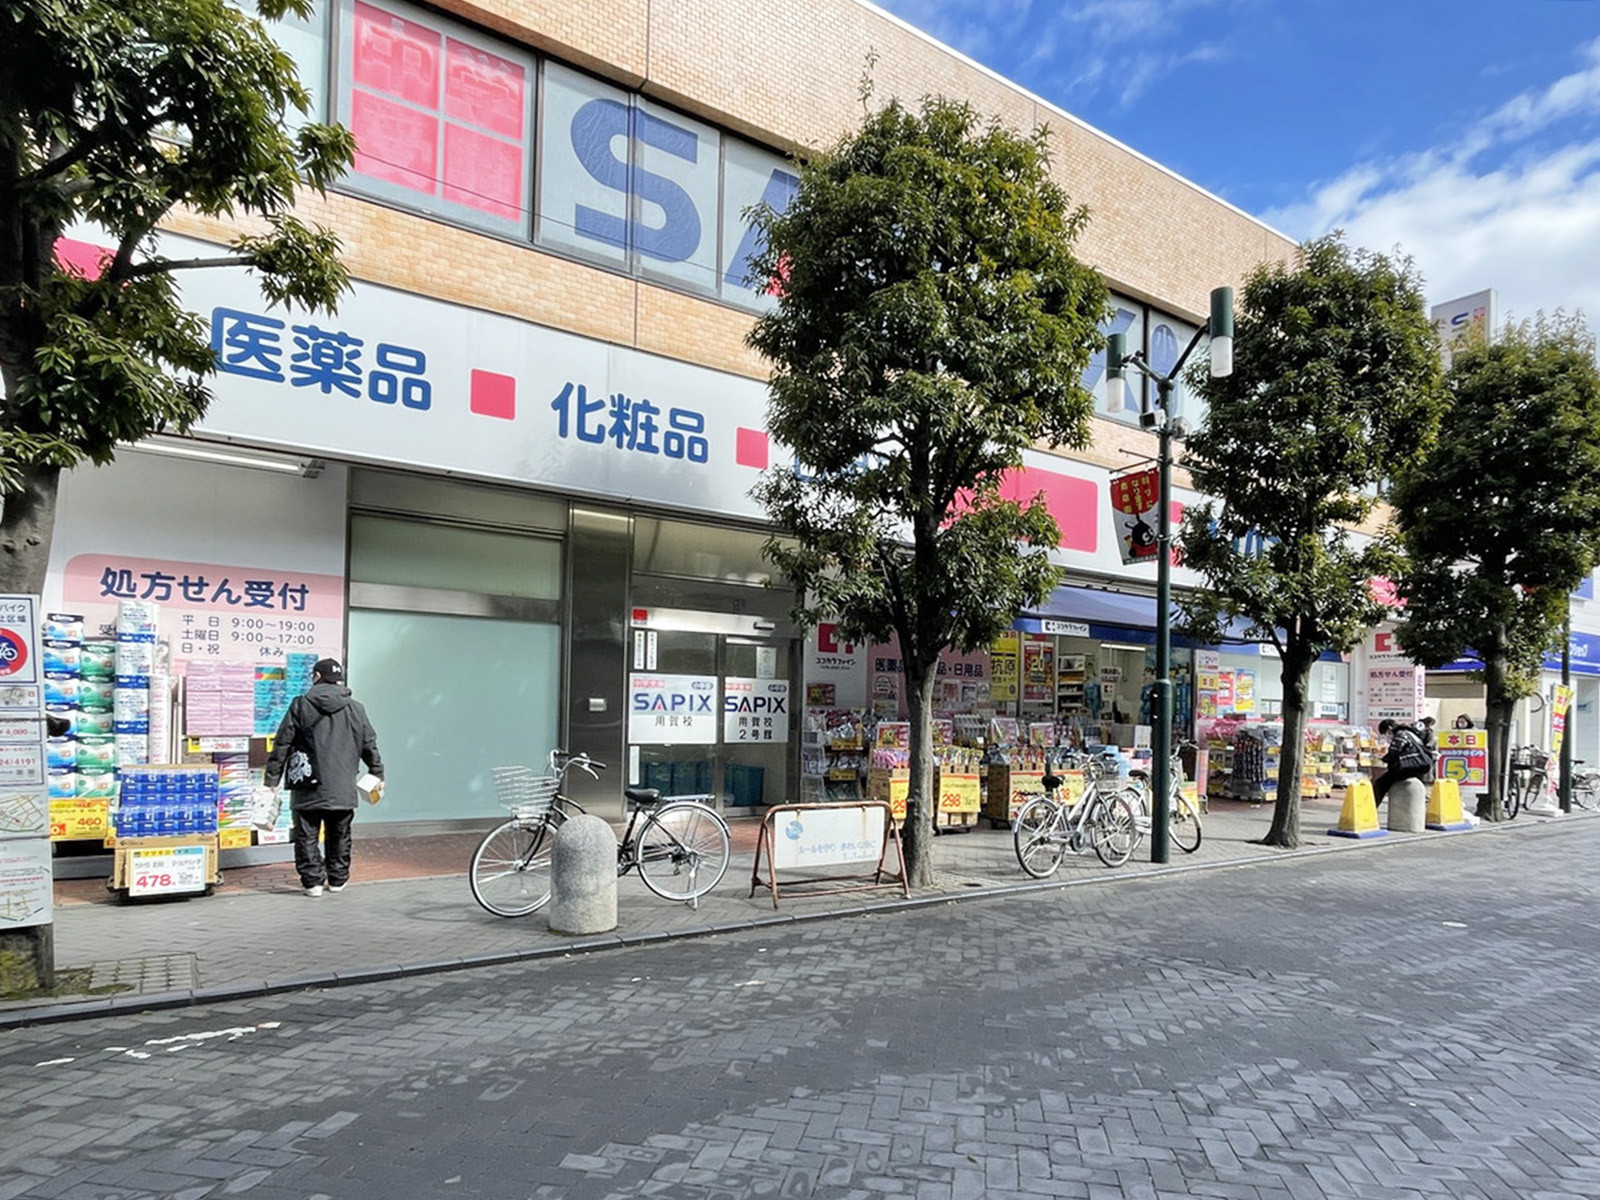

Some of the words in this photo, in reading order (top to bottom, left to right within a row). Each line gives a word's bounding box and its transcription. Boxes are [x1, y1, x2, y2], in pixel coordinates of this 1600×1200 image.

[212, 306, 432, 411] 医薬品
[551, 382, 709, 464] 化粧品
[100, 567, 310, 611] 処方せん受付
[182, 629, 219, 641] 土曜日
[259, 646, 284, 657] 休み
[990, 658, 1016, 675] 抗原
[634, 693, 712, 712] SAPIX
[724, 696, 786, 714] SAPIX
[655, 716, 693, 727] 用賀校
[738, 717, 773, 728] 用賀校
[738, 730, 773, 740] 2号館
[1447, 734, 1476, 746] 本日
[941, 793, 961, 808] 298
[77, 817, 102, 826] 460
[136, 874, 172, 888] 478
